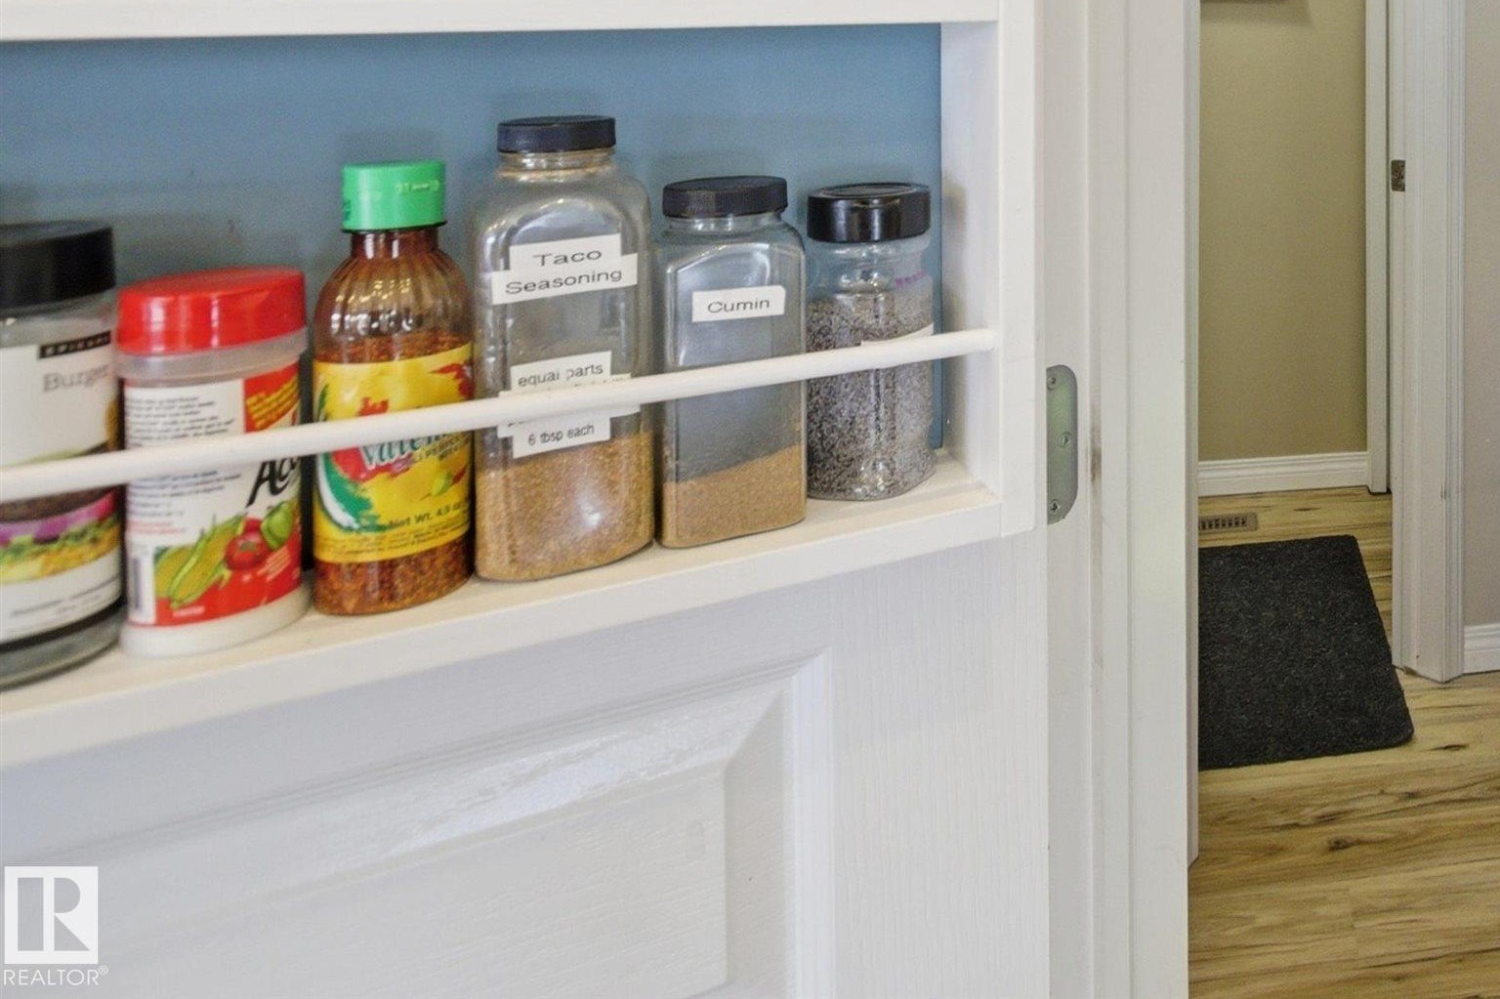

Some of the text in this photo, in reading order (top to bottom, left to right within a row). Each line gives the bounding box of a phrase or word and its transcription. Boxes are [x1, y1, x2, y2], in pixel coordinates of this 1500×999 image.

[533, 248, 603, 268] Taco
[504, 267, 623, 296] Seasoning
[706, 297, 772, 315] Cumin
[517, 363, 604, 388] equal parts
[527, 432, 537, 447] 6
[566, 422, 596, 440] each
